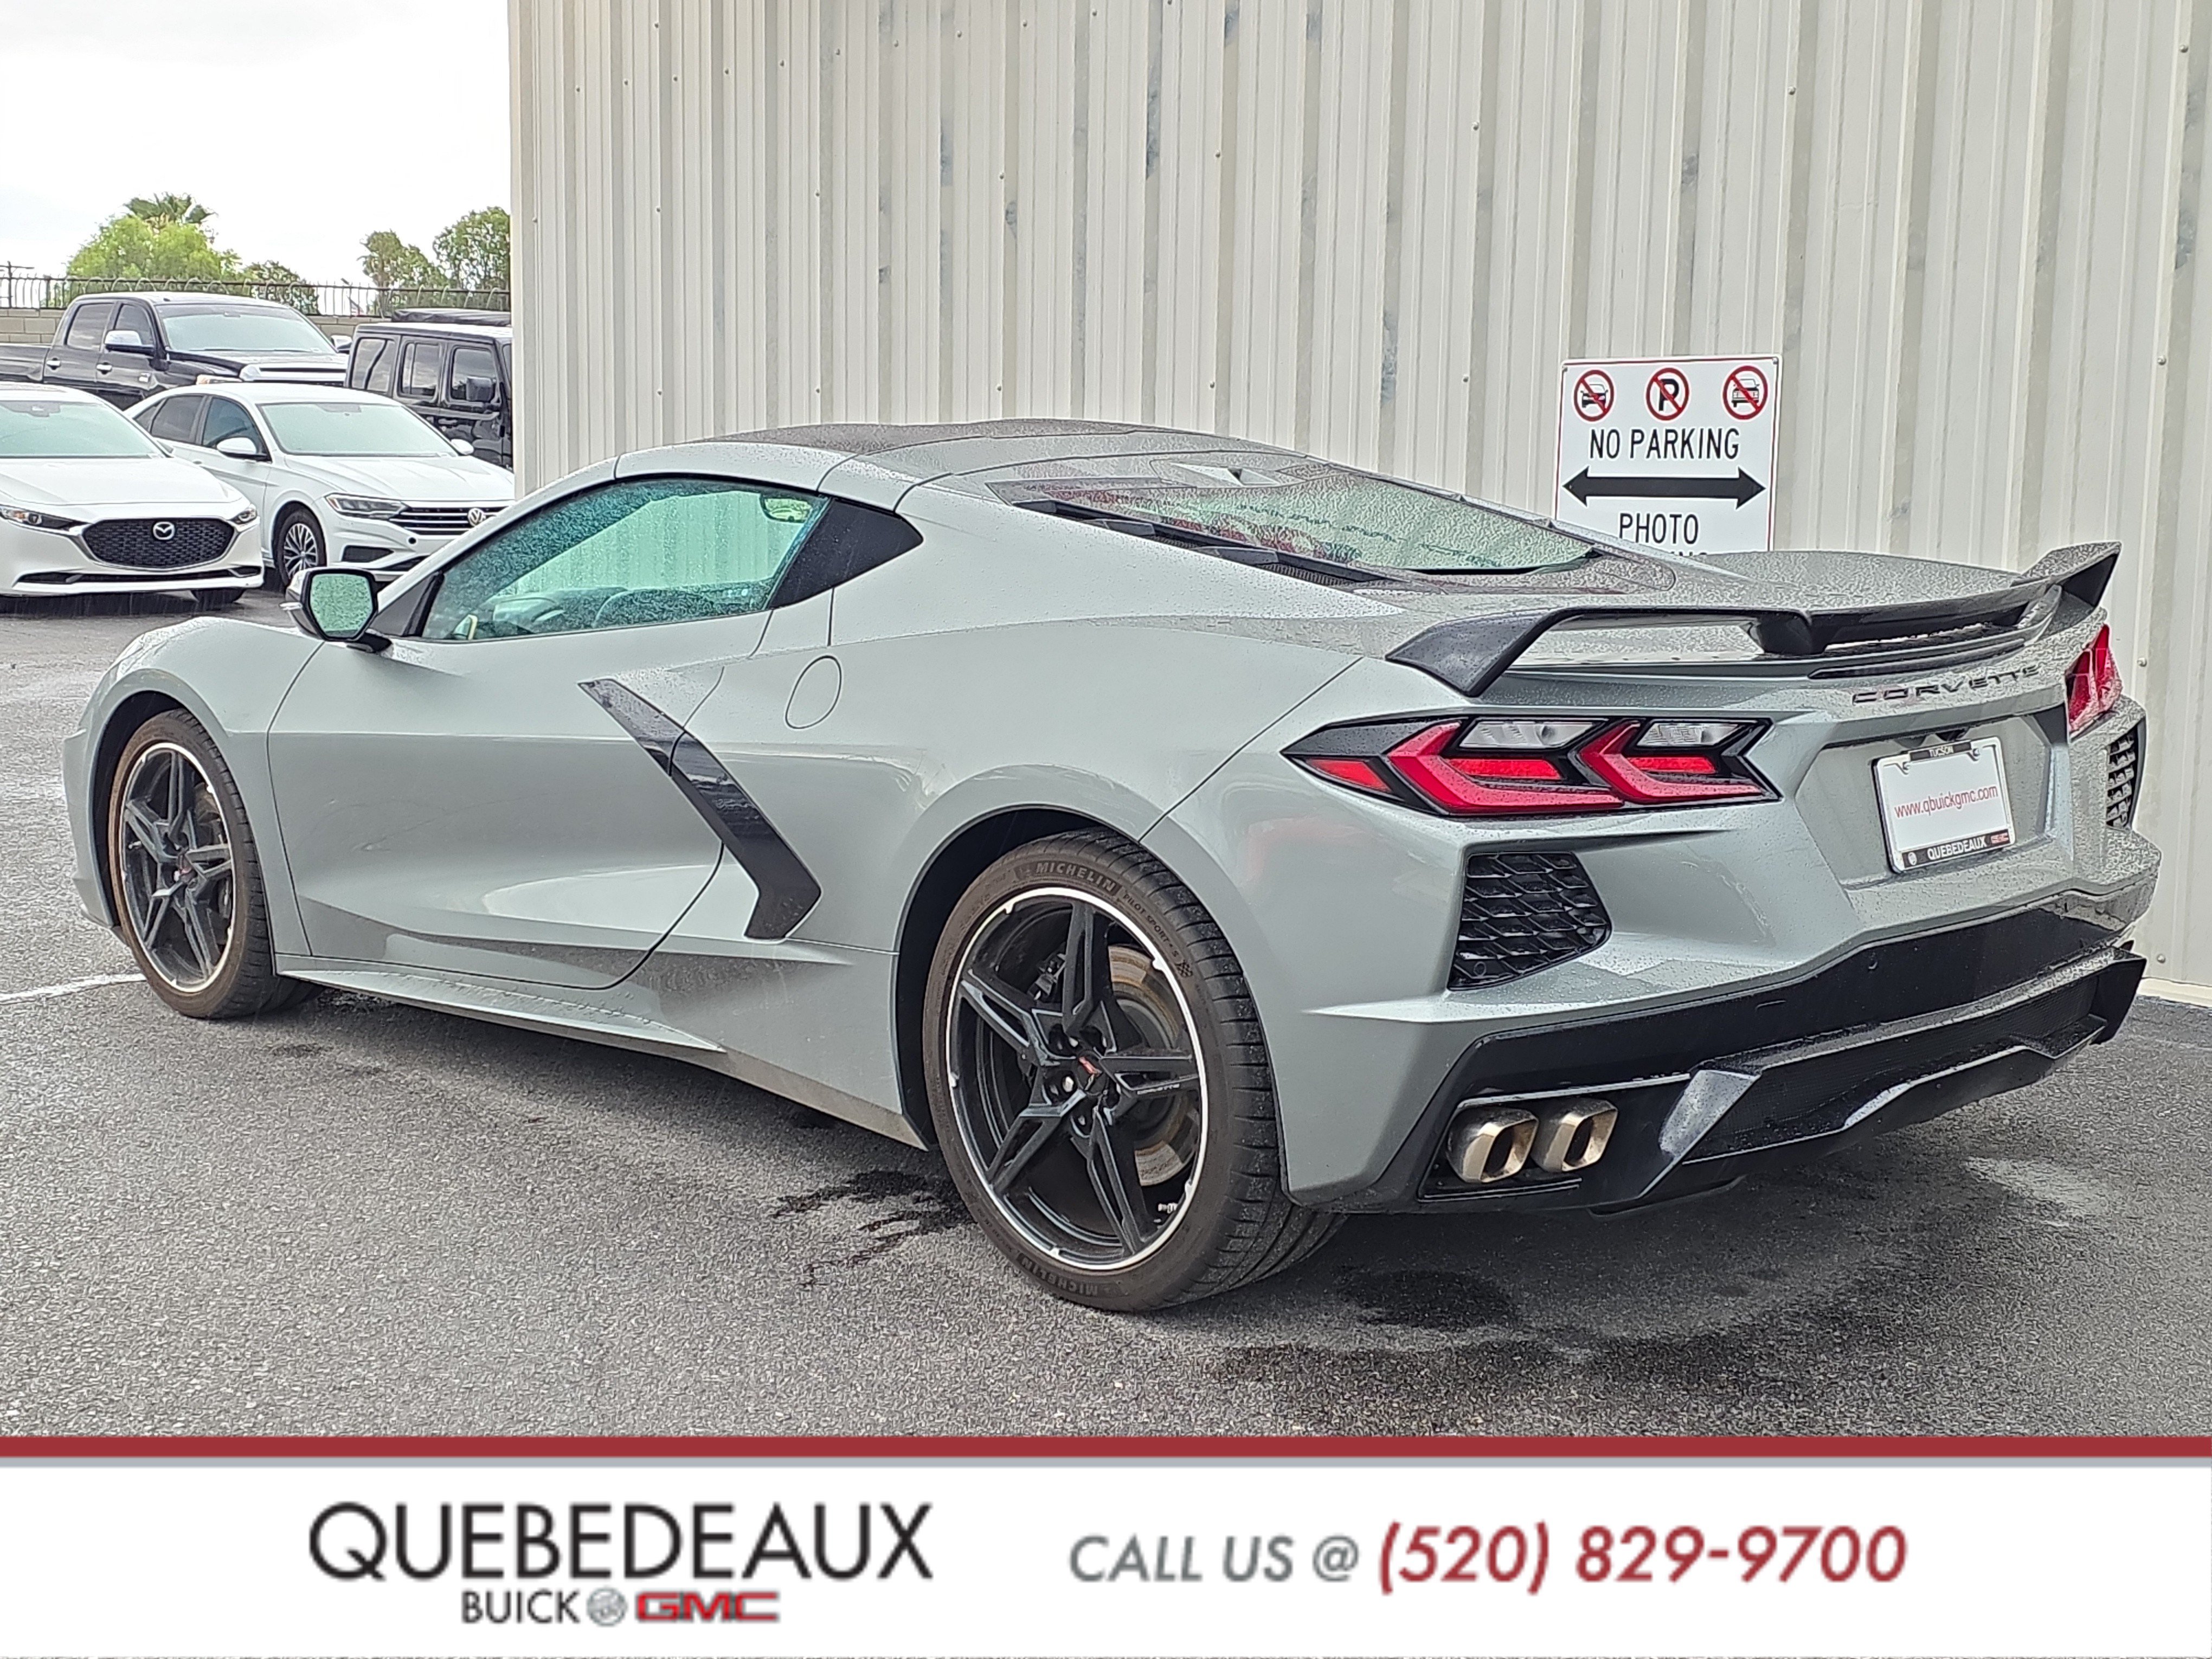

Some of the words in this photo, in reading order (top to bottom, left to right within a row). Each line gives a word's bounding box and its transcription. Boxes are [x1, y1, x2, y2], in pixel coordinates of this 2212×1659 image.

[1590, 429, 1620, 459] NO
[1630, 428, 1740, 459] PARKING
[1619, 513, 1699, 544] PHOTO
[1852, 664, 2041, 705] CORVETTE
[1894, 785, 1999, 818] www.qbuickgmc.com
[1926, 835, 1988, 860] QUEBEDEAUX
[1036, 862, 1116, 892] MICHELIN
[1124, 893, 1145, 914] PILOT
[1146, 915, 1170, 943] SPORT
[1020, 1257, 1098, 1295] MICHELIN
